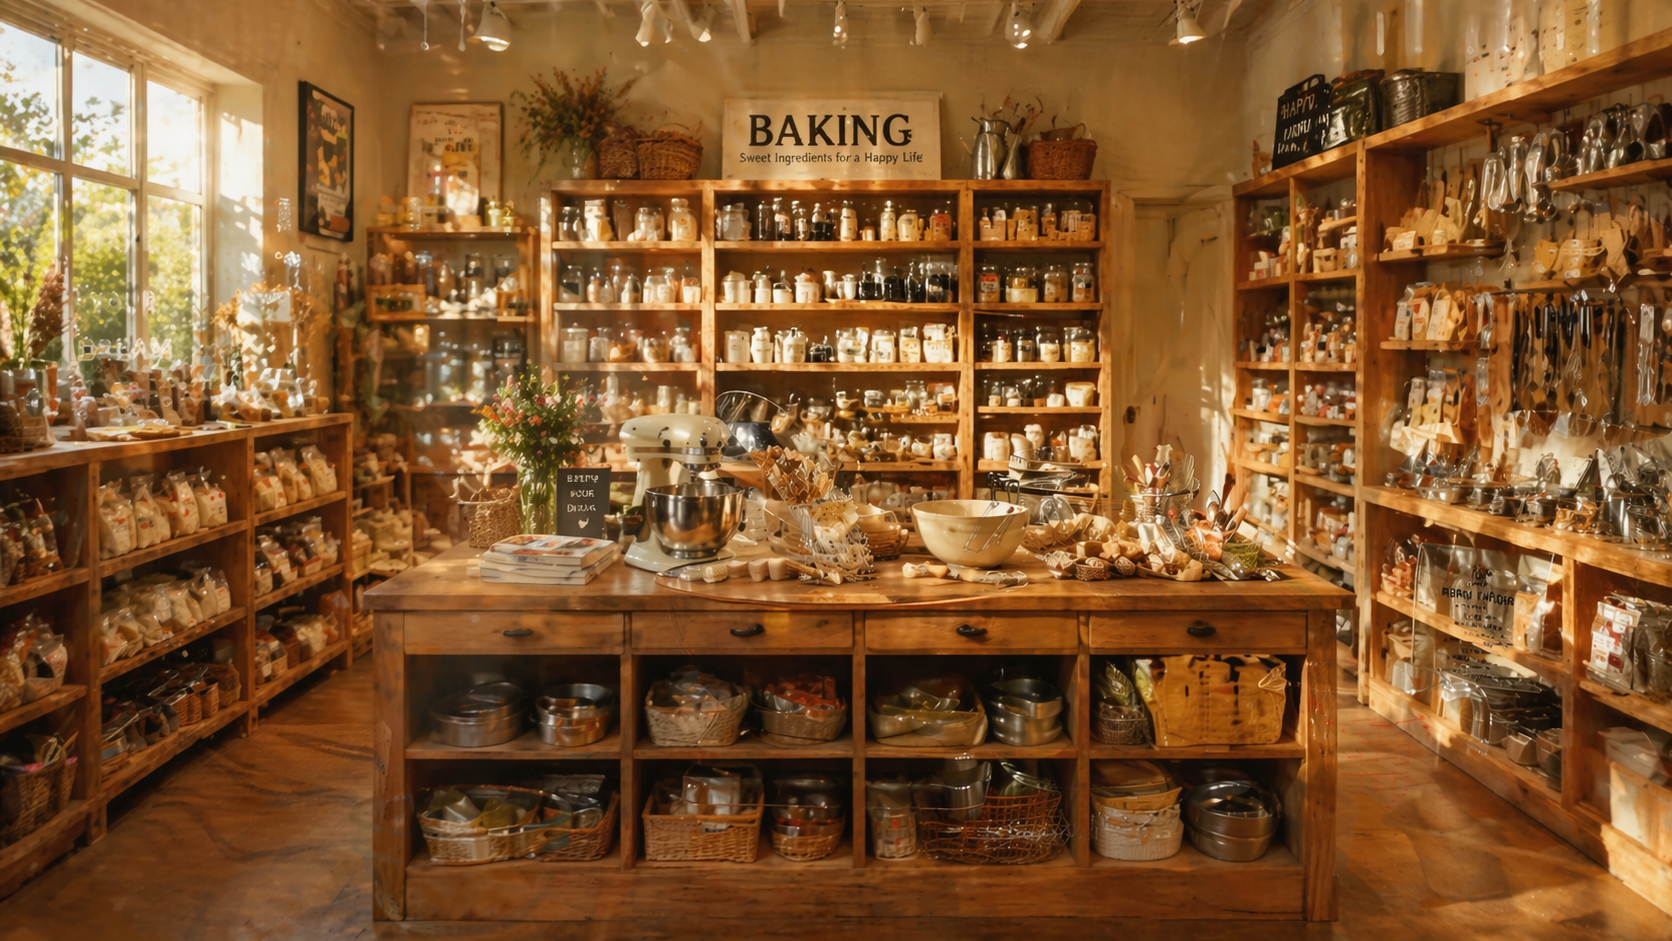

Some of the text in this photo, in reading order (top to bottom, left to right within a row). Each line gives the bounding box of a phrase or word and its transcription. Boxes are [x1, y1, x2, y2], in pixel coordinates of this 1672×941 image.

[748, 113, 913, 147] BAKING
[739, 152, 923, 166] Sweet Ingredients for a Happy Life
